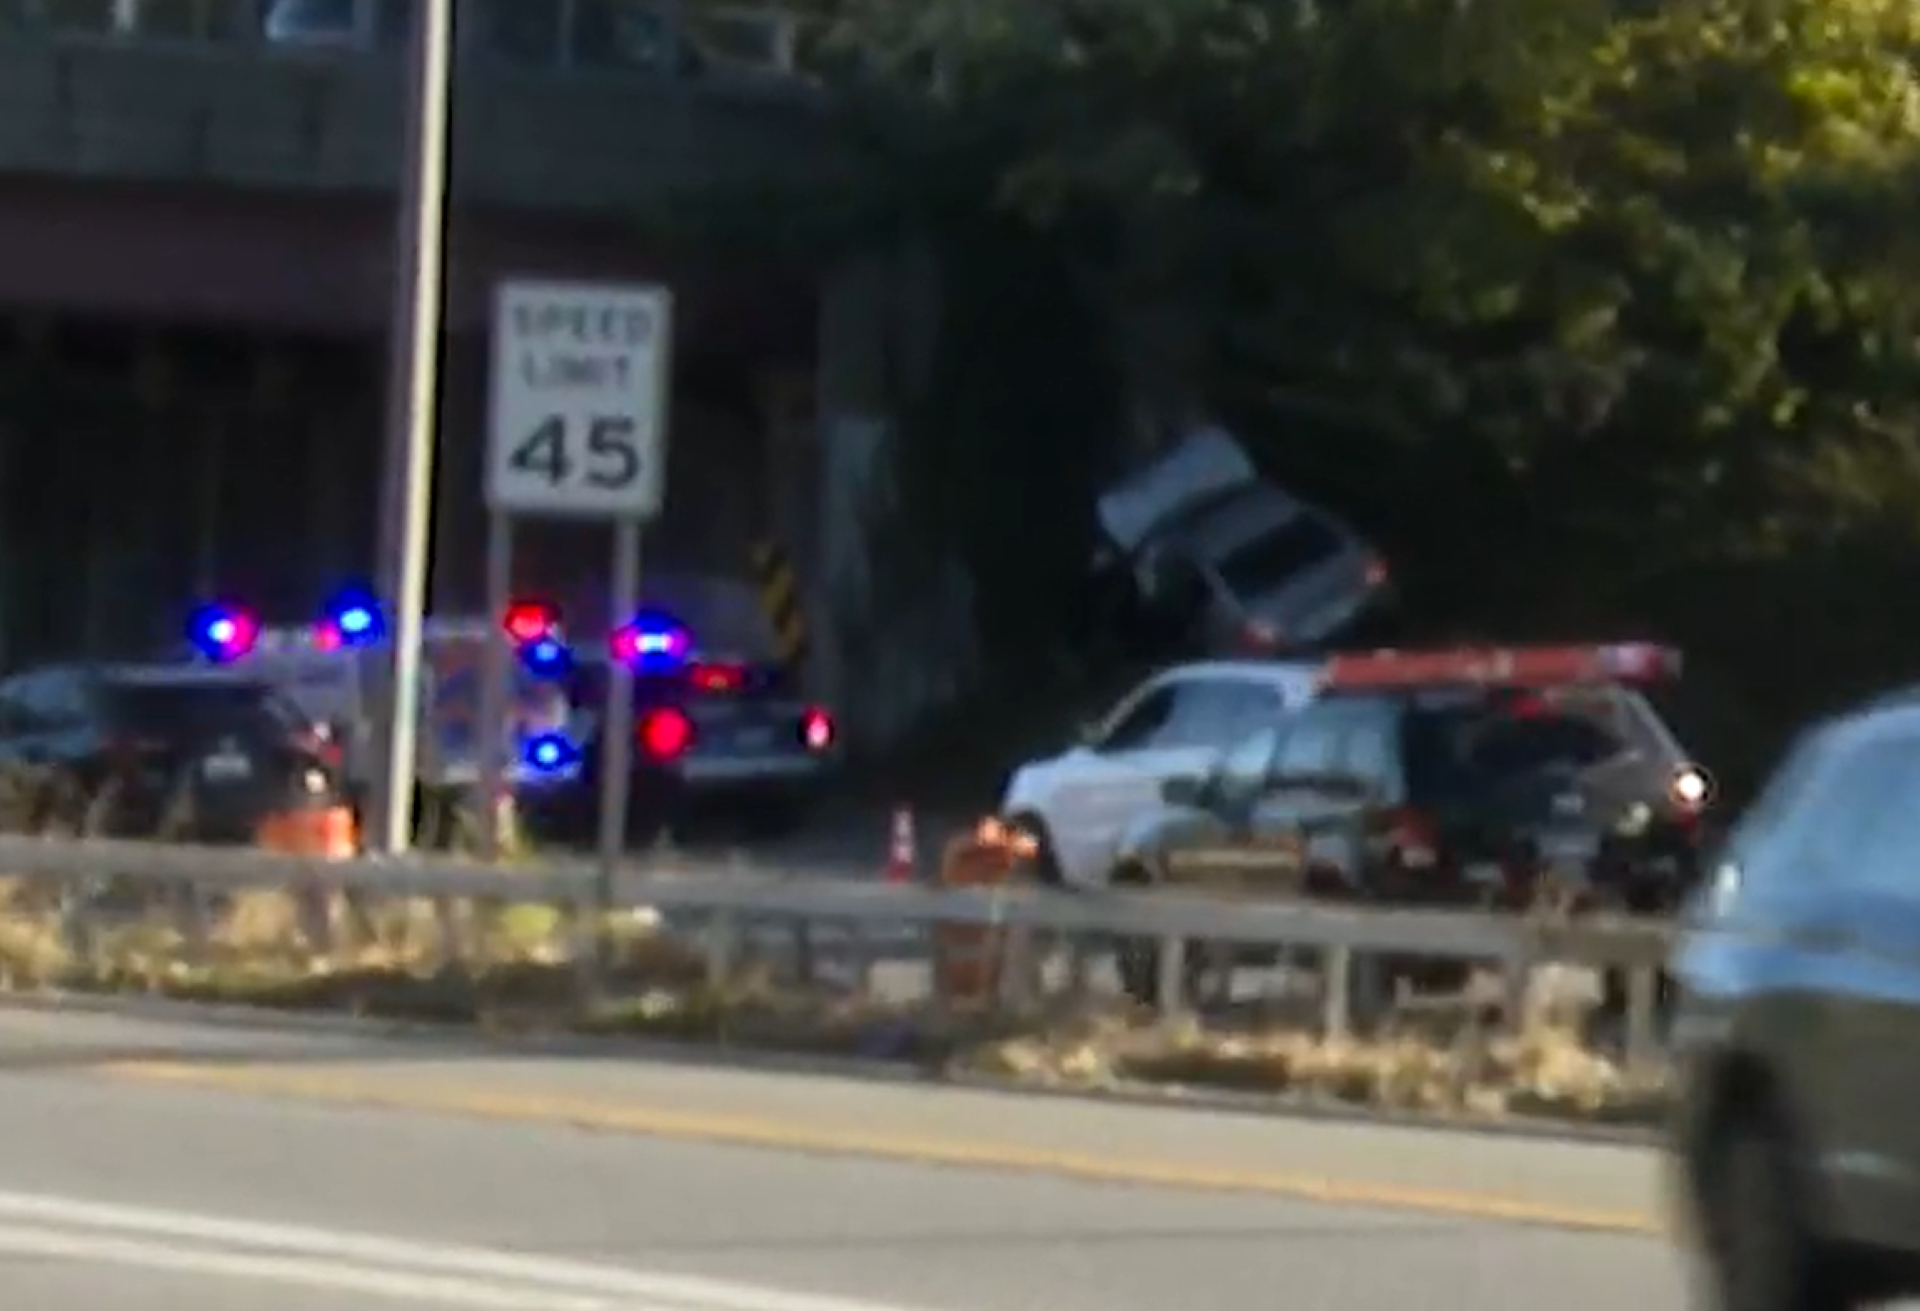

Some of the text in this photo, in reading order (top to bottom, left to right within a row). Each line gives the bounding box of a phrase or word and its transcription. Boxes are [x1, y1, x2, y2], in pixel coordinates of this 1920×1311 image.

[512, 304, 651, 344] SPEED
[521, 352, 633, 390] LIMIT
[509, 413, 641, 491] 45
